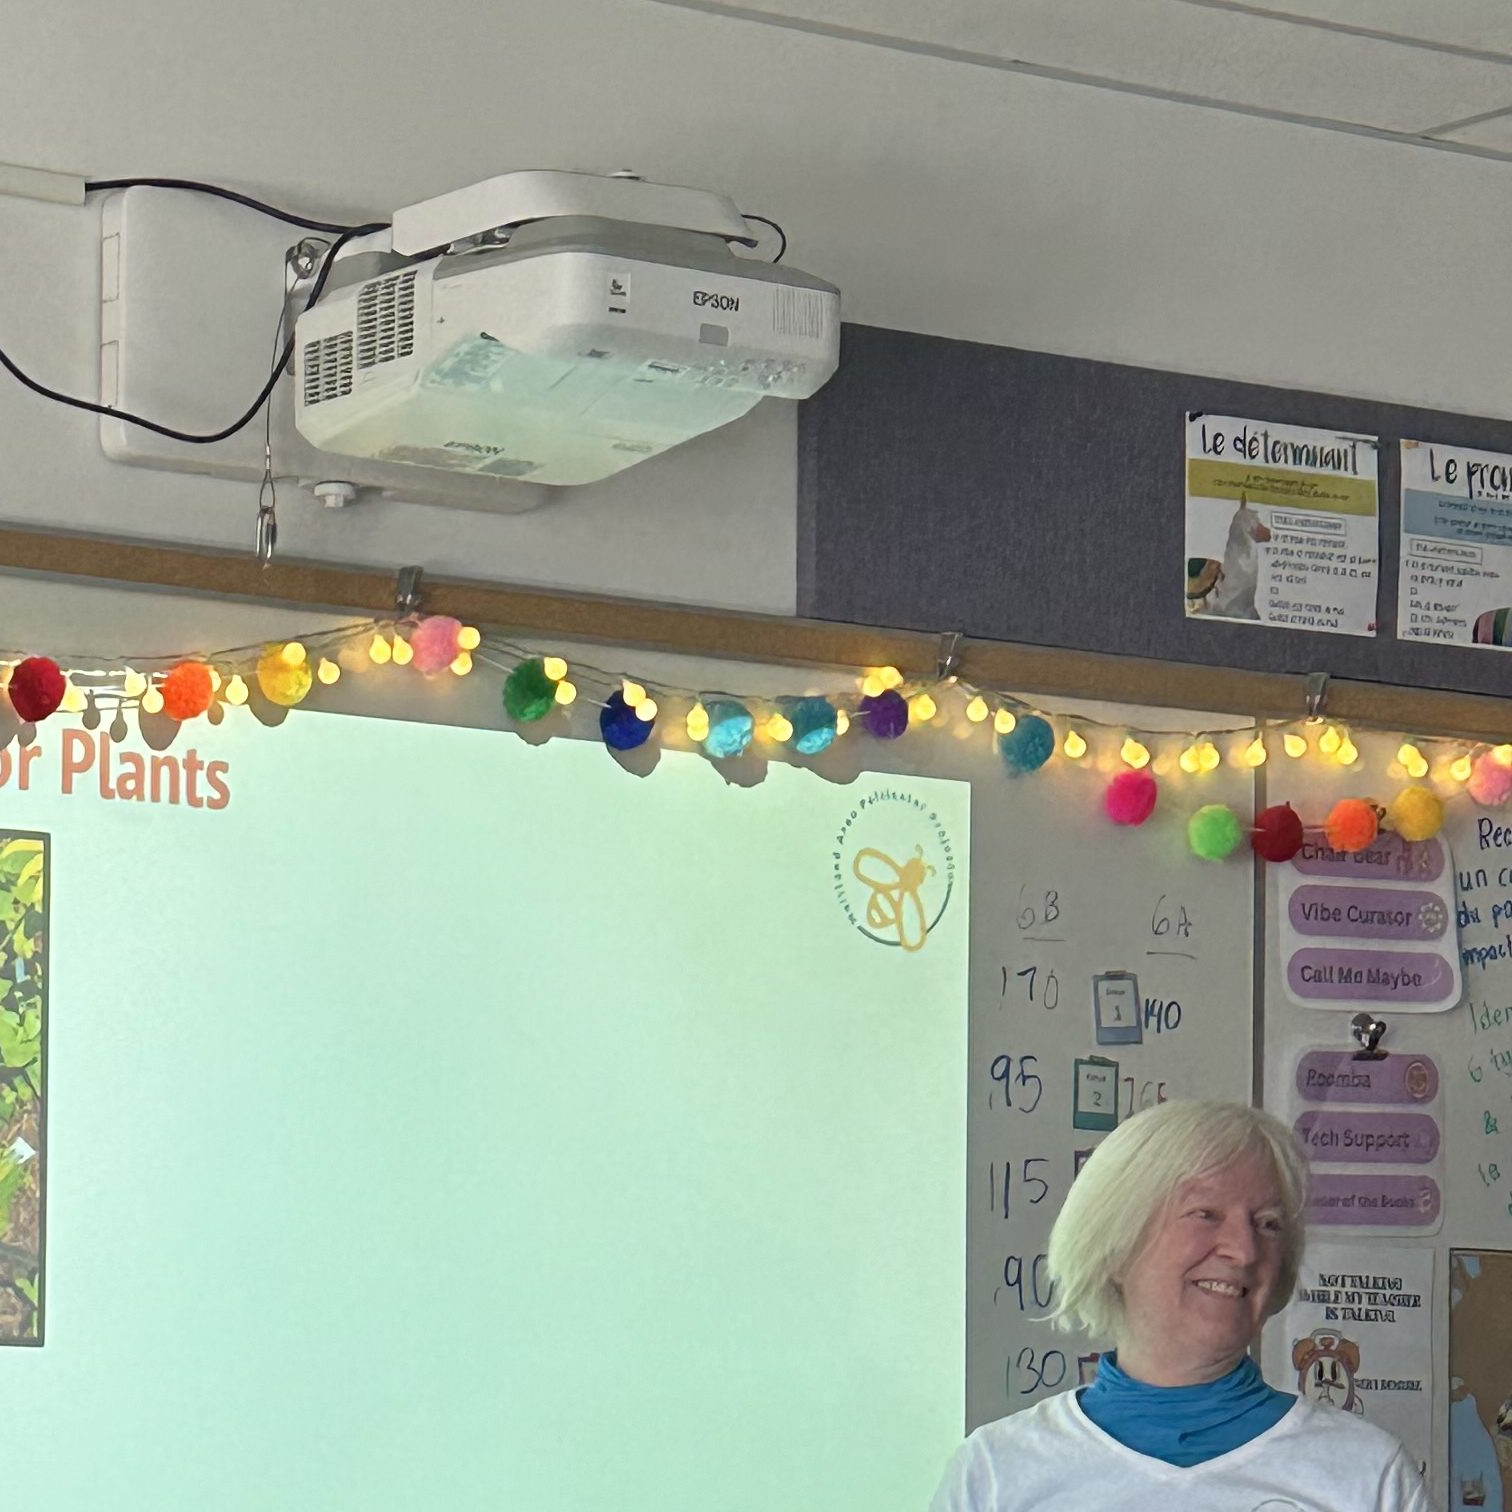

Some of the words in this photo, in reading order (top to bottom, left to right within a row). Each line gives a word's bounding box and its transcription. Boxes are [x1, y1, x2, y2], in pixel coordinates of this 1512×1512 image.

[693, 290, 740, 312] EPSON
[1201, 424, 1226, 456] Le
[1429, 448, 1458, 484] Le
[61, 728, 231, 811] Plants
[1301, 903, 1342, 923] Vibe
[1301, 965, 1334, 984] Call
[1302, 1128, 1339, 1147] Tech
[1343, 1129, 1410, 1152] Support
[990, 1158, 1049, 1219] 115
